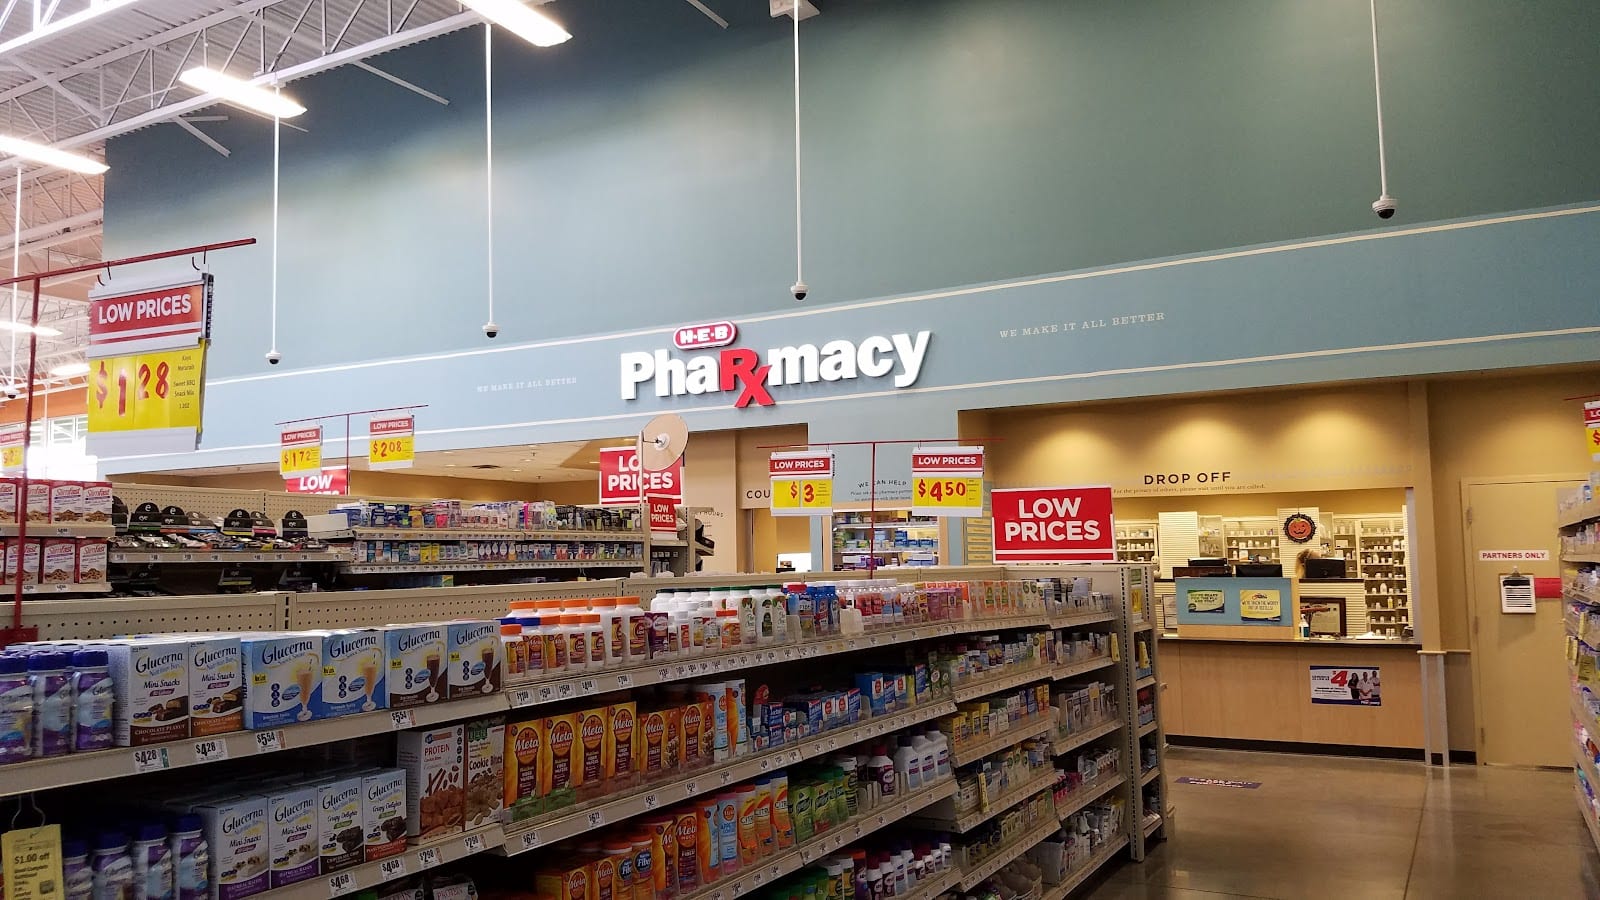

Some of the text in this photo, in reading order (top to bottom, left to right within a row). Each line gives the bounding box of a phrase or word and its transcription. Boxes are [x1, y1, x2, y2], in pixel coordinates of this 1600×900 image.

[98, 294, 192, 325] LOW PRICES
[1000, 312, 1166, 339] WE MAKE IT ALL BETTER
[373, 420, 409, 430] LOW PRICES
[284, 431, 317, 441] LOW PRICES
[618, 455, 641, 472] LO
[774, 460, 825, 469] LOW PRICES
[918, 456, 977, 465] LOW PRICES
[300, 474, 333, 491] LOW
[608, 472, 674, 492] PRICES
[1144, 471, 1231, 485] DROP OFF
[653, 504, 669, 513] LOW
[1018, 497, 1082, 519] LOW
[651, 513, 674, 523] PRICES
[1004, 520, 1101, 542] PRICES
[1482, 552, 1546, 560] PARTNERS ONLY
[398, 630, 440, 652] Glucerna
[456, 625, 494, 645] Glucerna
[262, 641, 313, 665] Glucerna
[330, 635, 376, 658] Glucerna
[135, 652, 183, 673] Glucerna
[194, 647, 237, 667] Glucerna
[144, 681, 159, 689] Mini
[583, 726, 603, 737] Meta
[613, 719, 633, 729] Meta
[515, 738, 539, 752] Meta
[551, 732, 573, 744] Meta
[195, 742, 216, 756] $428
[424, 743, 450, 757] PROTEIN
[135, 750, 157, 765] $428
[469, 757, 489, 771] Cookie
[368, 780, 403, 801] Glucerna
[322, 787, 358, 810] Glucerna
[274, 799, 314, 822] Glucerna
[222, 809, 263, 834] Glucerna
[14, 853, 37, 865] $1.00
